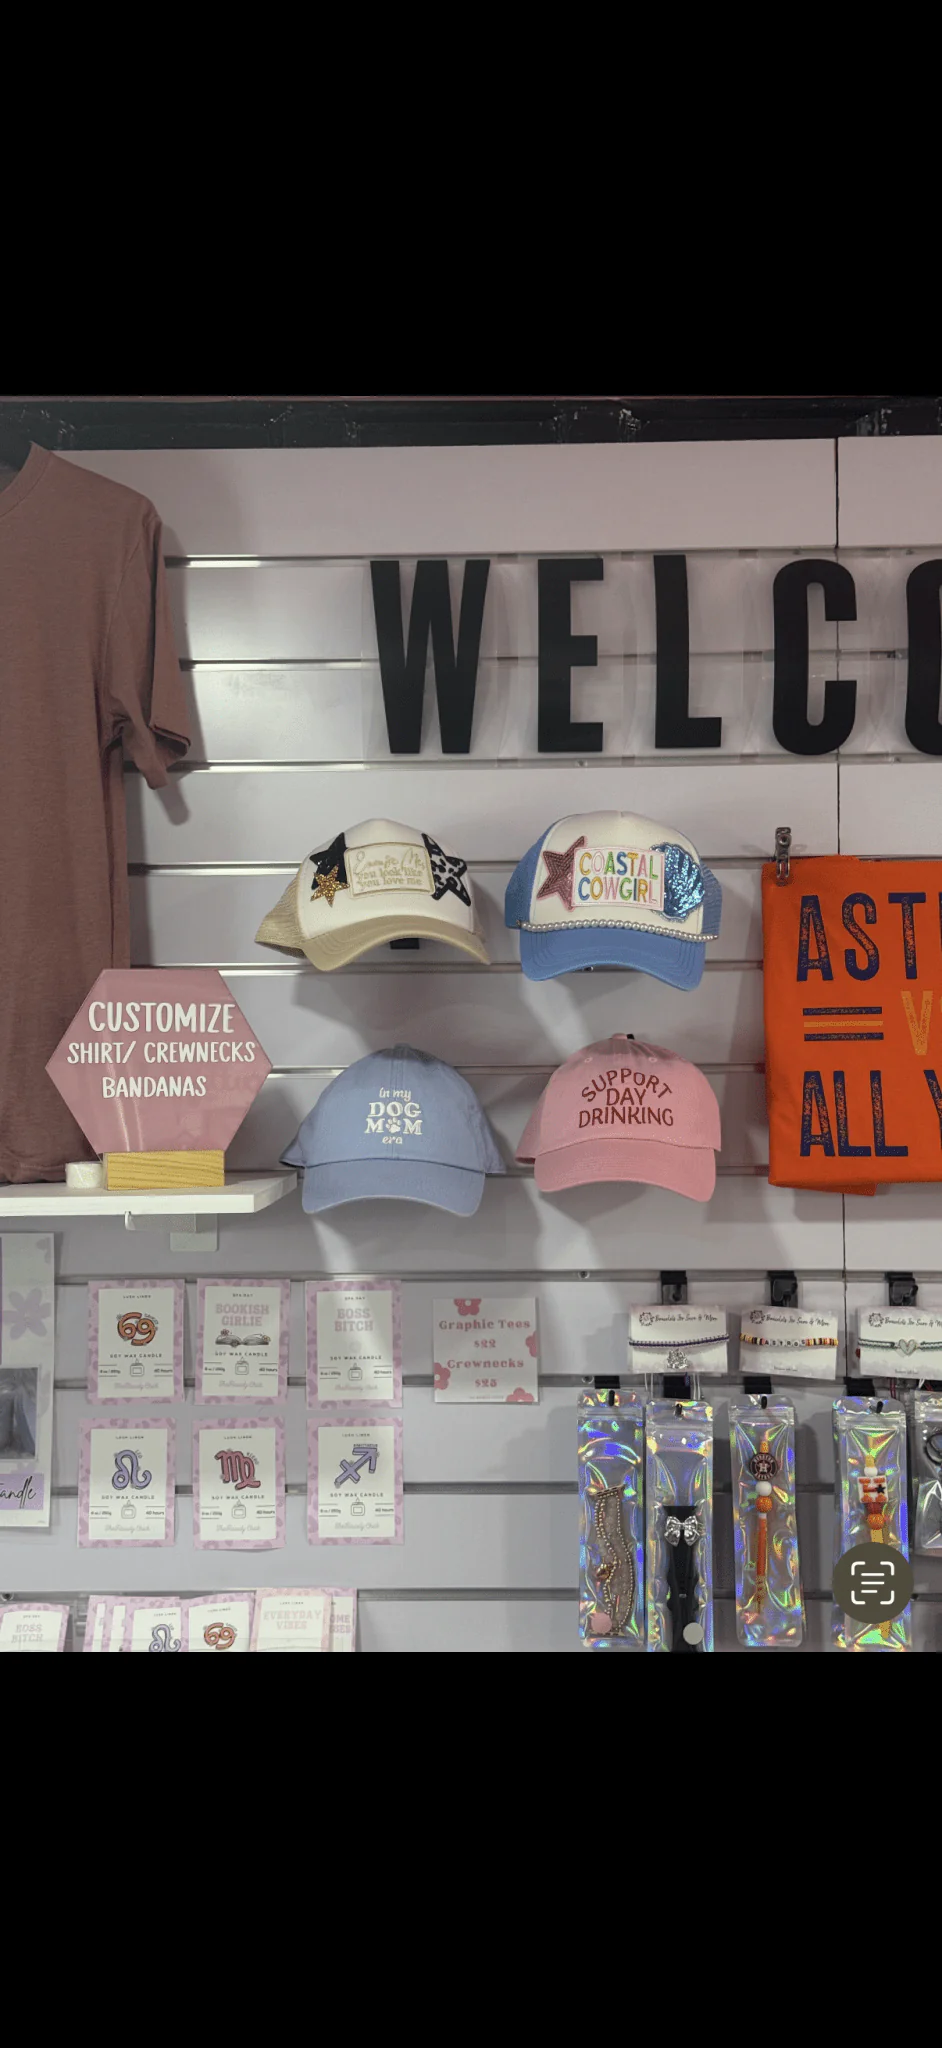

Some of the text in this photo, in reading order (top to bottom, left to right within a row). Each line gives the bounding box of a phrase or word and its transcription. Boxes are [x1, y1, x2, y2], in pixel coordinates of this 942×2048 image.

[579, 851, 659, 880] COASTAL
[578, 876, 658, 903] COWGIRL
[796, 892, 942, 982] AST
[88, 1001, 236, 1033] CUSTOMIZE
[901, 990, 942, 1056] V
[67, 1040, 256, 1064] SHIRT/ CREWNECKS
[102, 1075, 207, 1099] BANDANAS
[379, 1087, 411, 1102] in my
[581, 1068, 672, 1102] SUPPORT
[606, 1087, 646, 1106] DAY
[367, 1101, 421, 1118] DOG
[579, 1106, 674, 1128] DRINKING
[800, 1070, 909, 1157] ALL
[382, 1136, 403, 1145] era
[216, 1304, 269, 1315] BOOKISH
[337, 1308, 371, 1319] BOSS
[222, 1316, 262, 1326] GIRLIE
[334, 1320, 374, 1332] BITCH
[439, 1319, 530, 1331] Graphic Tees
[765, 1339, 805, 1347] ASTROS
[447, 1358, 524, 1369] Crewnecks
[0, 1475, 37, 1509] andle
[264, 1610, 322, 1621] EVERYDAY
